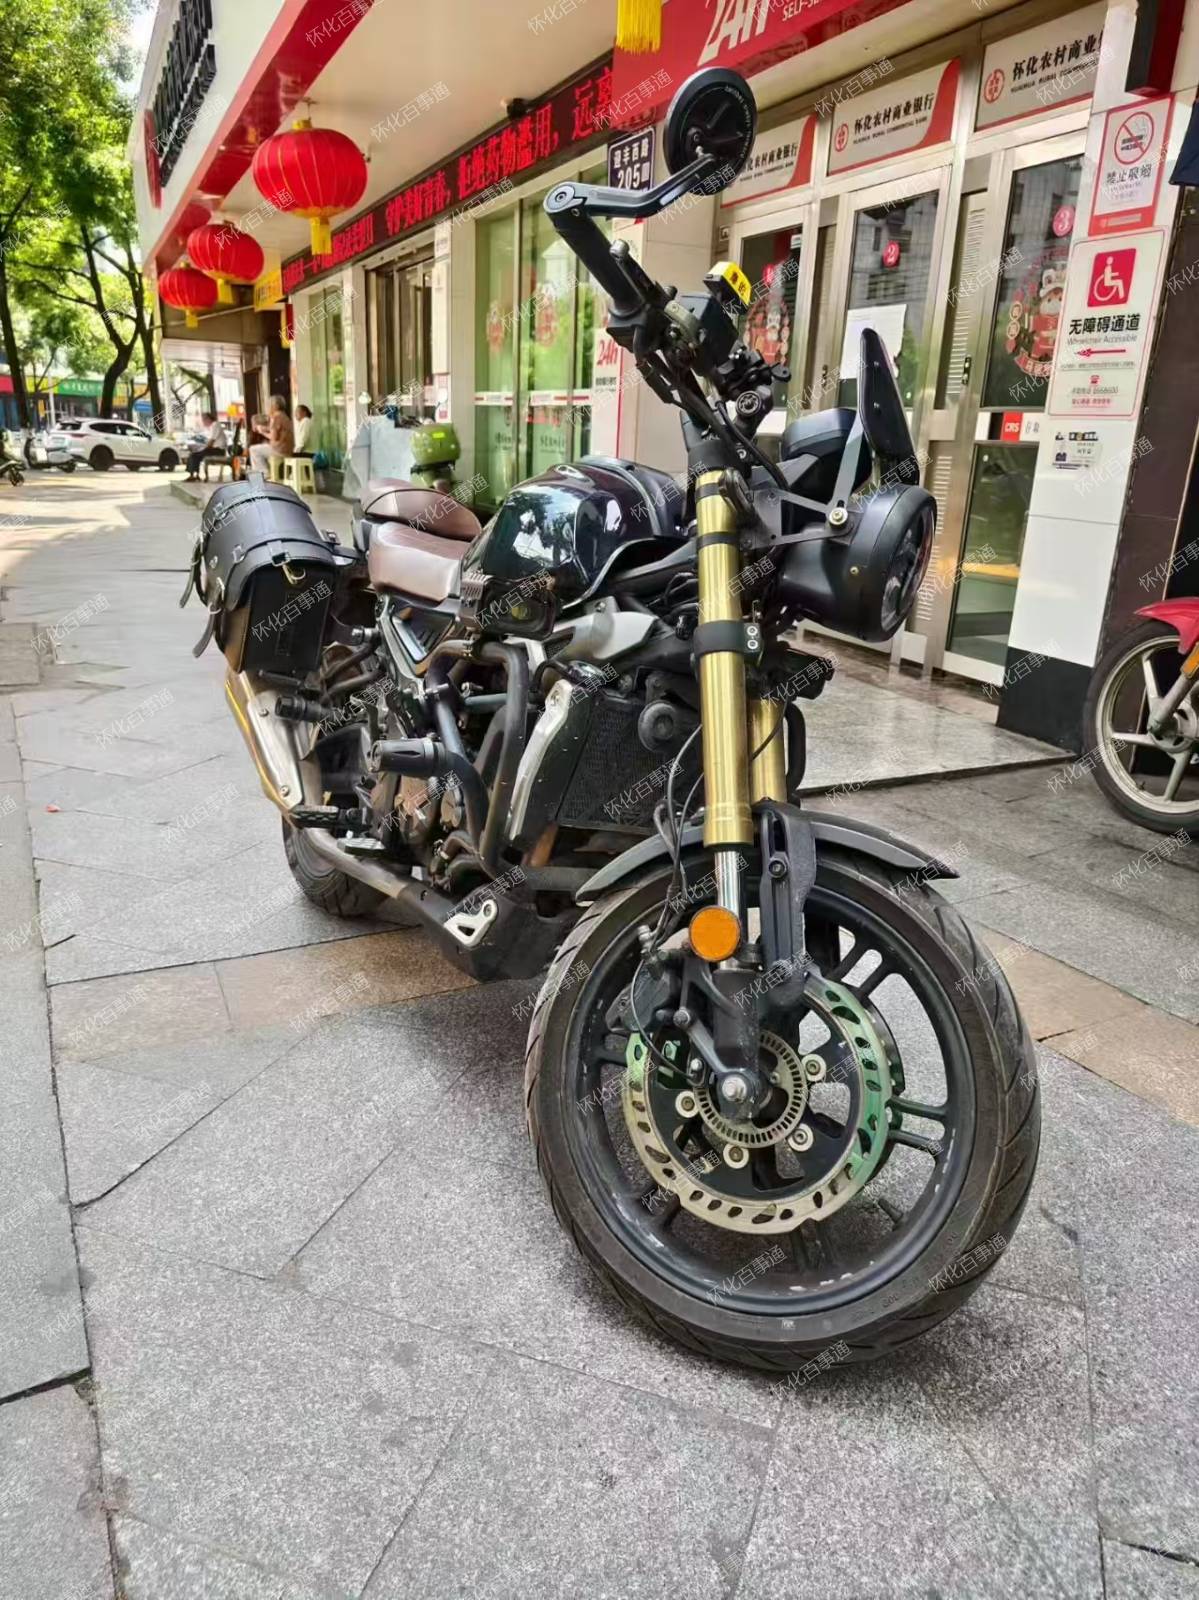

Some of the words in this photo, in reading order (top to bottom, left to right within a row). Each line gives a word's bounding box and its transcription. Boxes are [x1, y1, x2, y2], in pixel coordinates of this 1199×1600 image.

[854, 92, 934, 134] 怀化农村商业银行
[745, 141, 798, 172] 化农村商业银行
[1068, 313, 1141, 335] 无障碍通道
[1004, 422, 1019, 433] CRS
